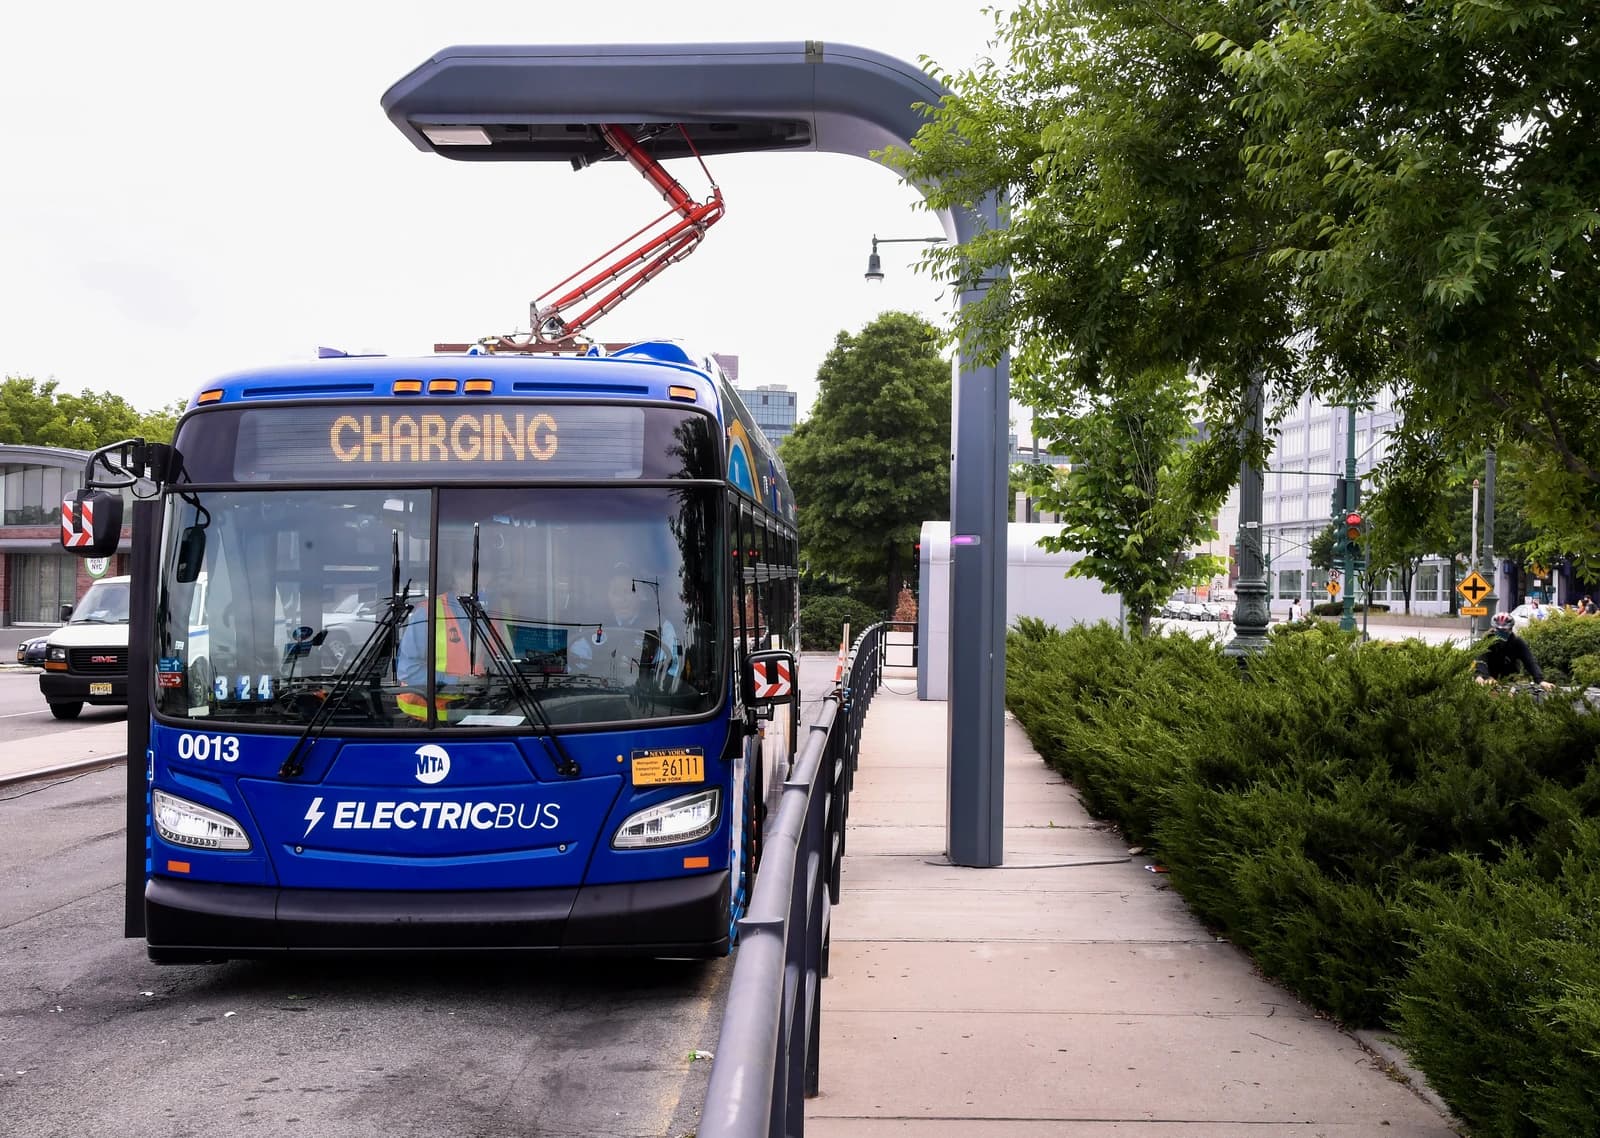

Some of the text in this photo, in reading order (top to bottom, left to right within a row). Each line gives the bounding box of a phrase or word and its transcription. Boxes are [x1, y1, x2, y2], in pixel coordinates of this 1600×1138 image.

[330, 413, 558, 462] CHARGING
[91, 655, 118, 663] GMC
[215, 674, 270, 700] 3 2 4
[178, 733, 240, 762] 0013
[332, 801, 561, 830] ELECTRICBUS
